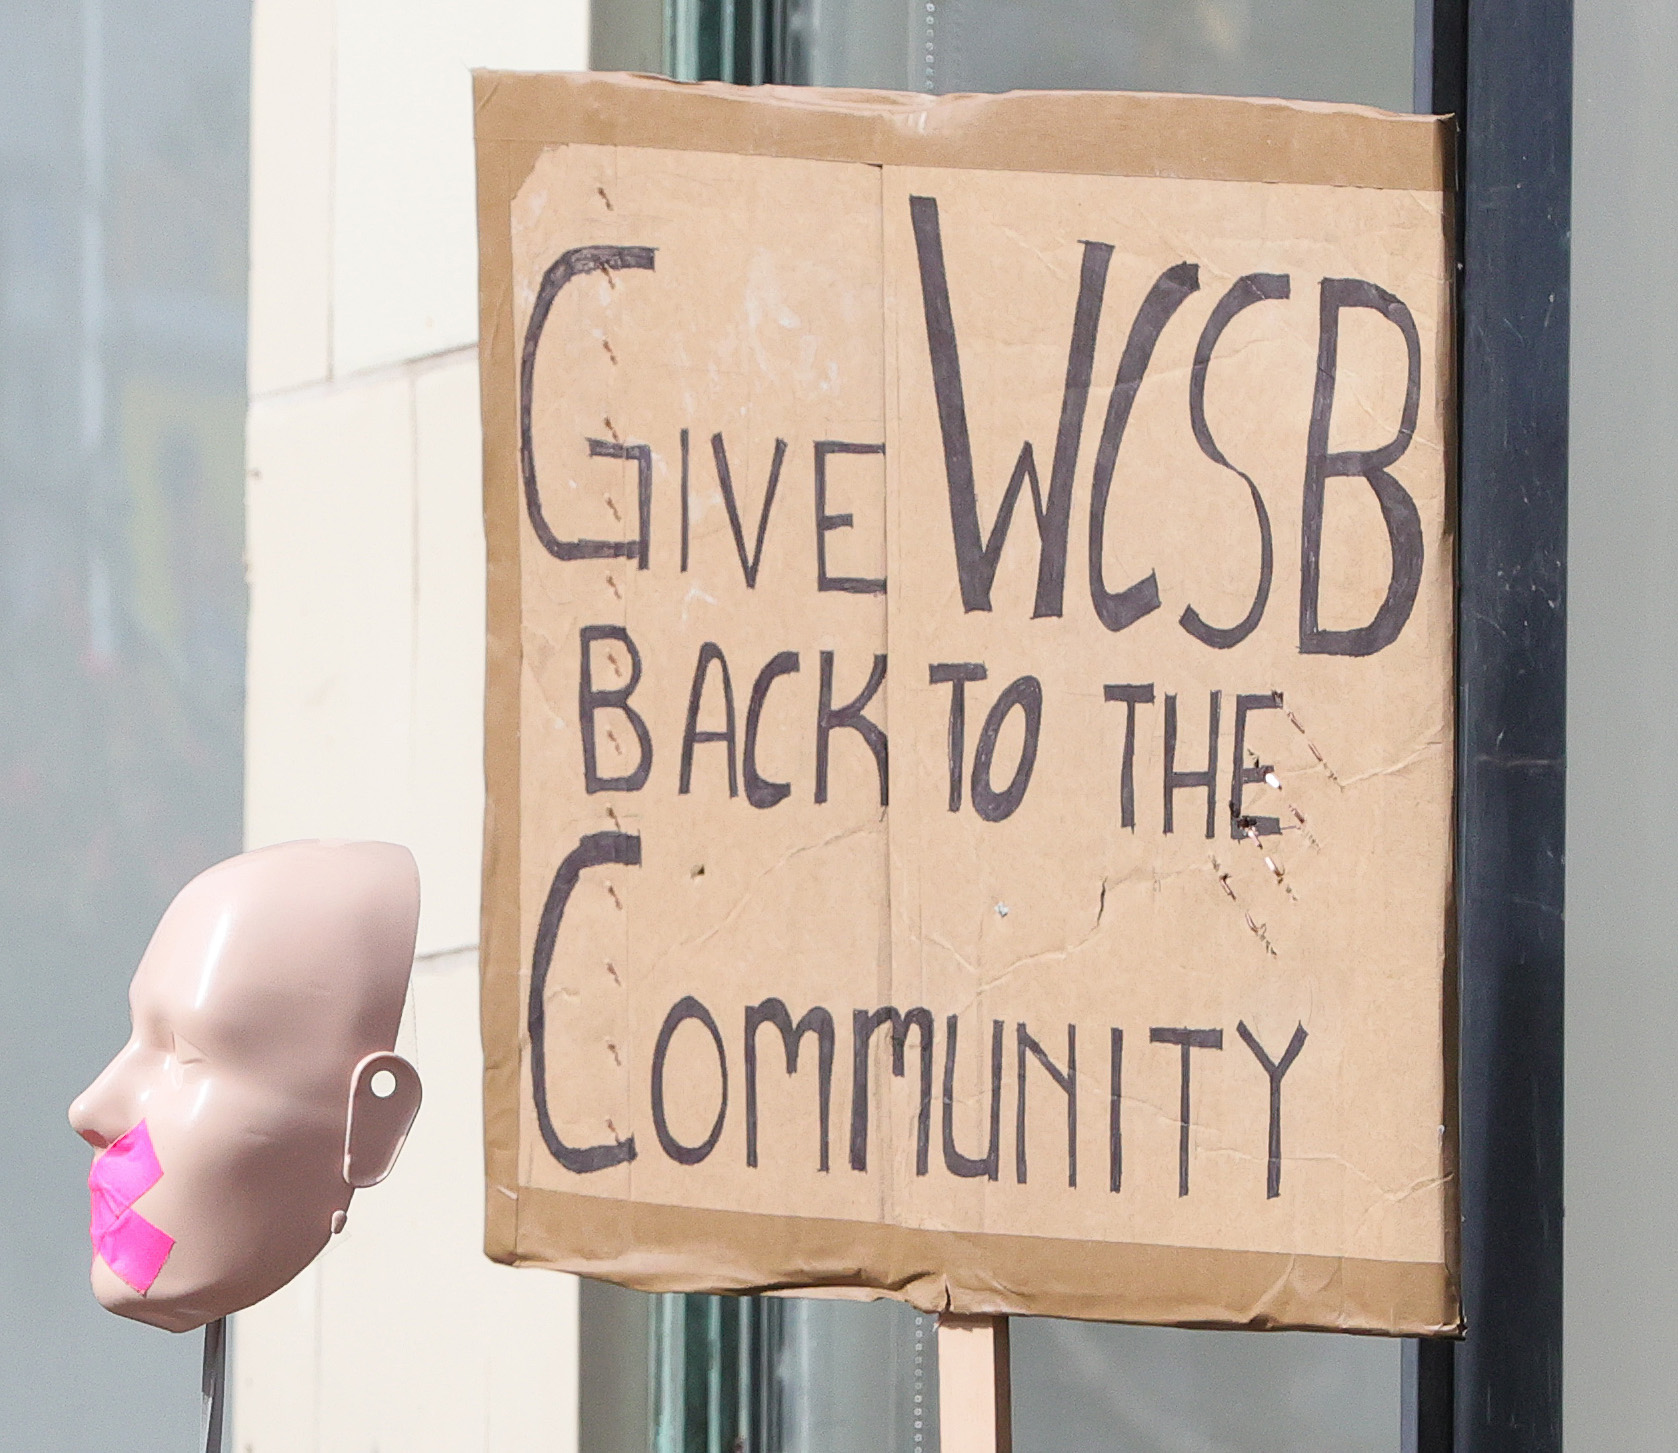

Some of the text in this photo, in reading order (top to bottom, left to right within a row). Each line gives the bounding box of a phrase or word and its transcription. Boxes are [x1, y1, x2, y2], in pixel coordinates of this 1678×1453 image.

[521, 196, 1423, 655] GIVE WCSB
[580, 624, 1283, 840] BACK TO THE
[530, 830, 1309, 1200] COMMUNITY
